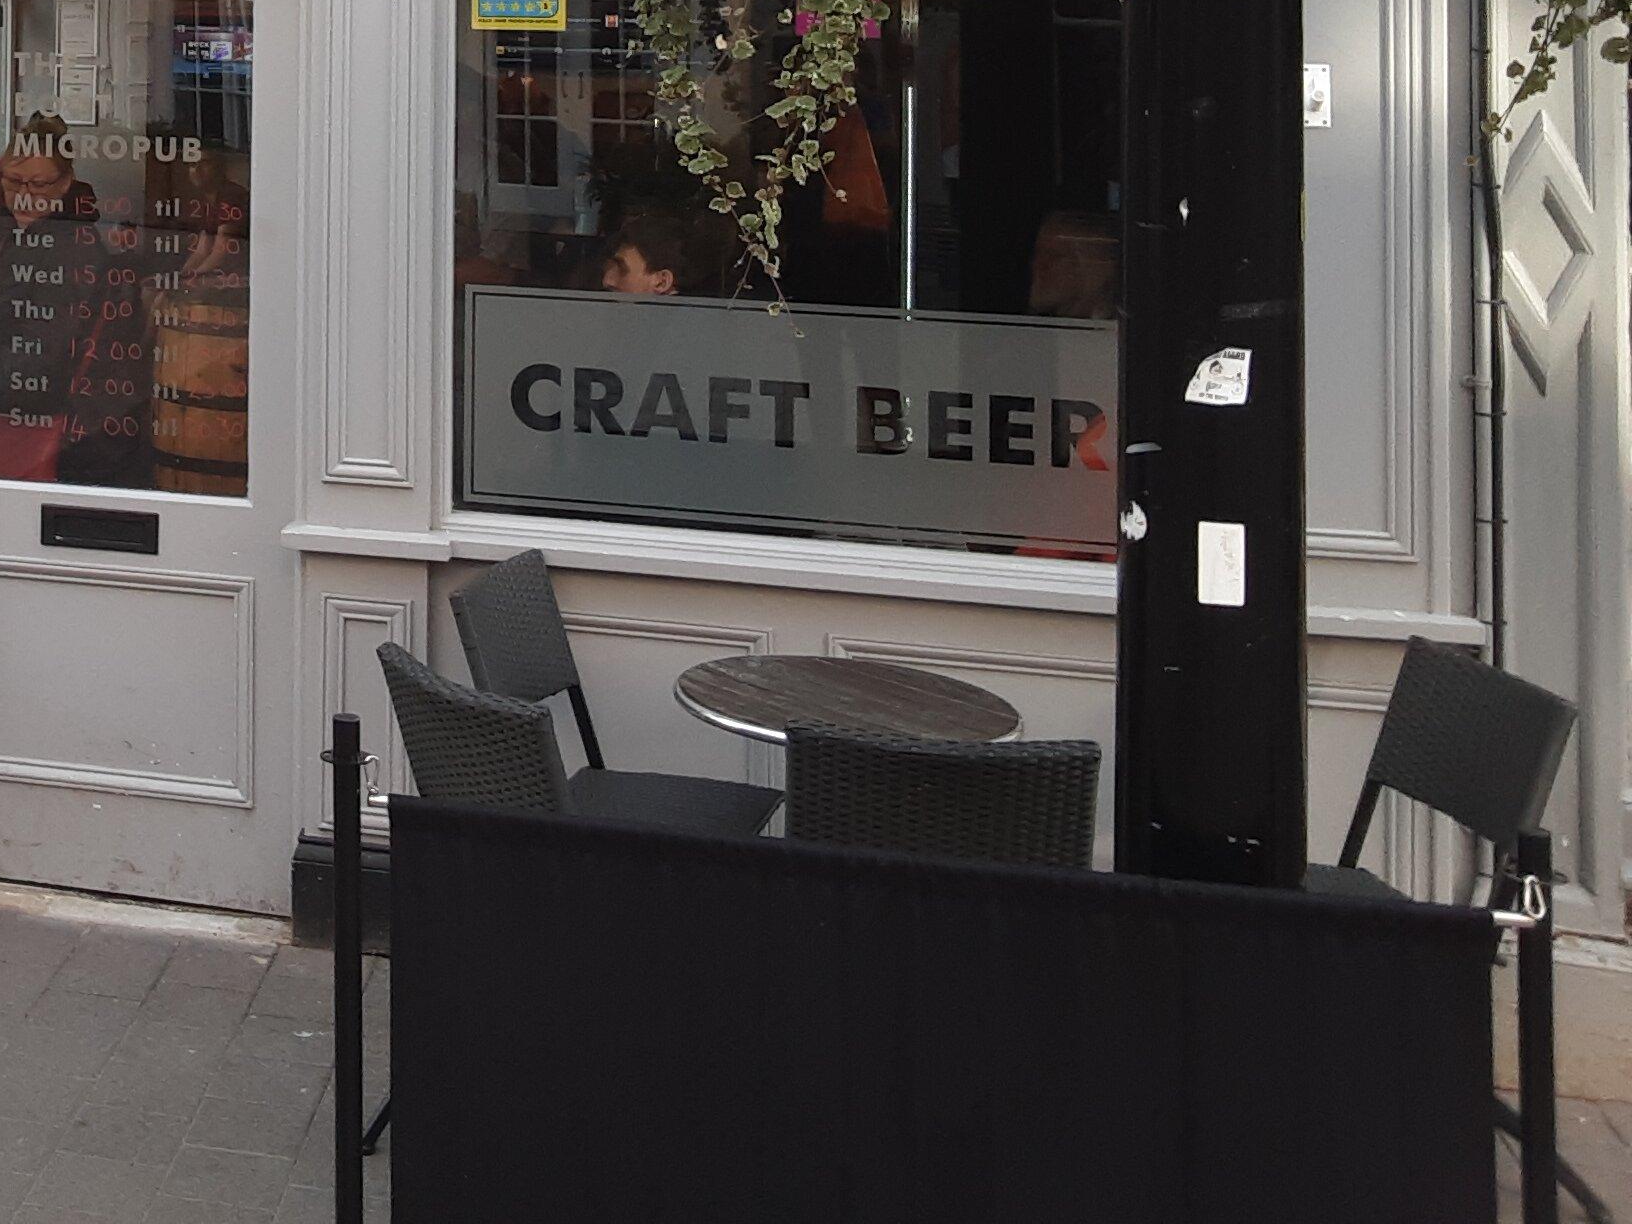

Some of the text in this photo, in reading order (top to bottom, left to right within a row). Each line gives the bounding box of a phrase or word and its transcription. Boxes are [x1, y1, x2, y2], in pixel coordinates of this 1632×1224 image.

[13, 133, 203, 163] MICROPUB
[13, 193, 64, 213] Mon
[155, 198, 180, 217] til
[13, 228, 55, 248] Tue
[155, 234, 180, 254] til
[11, 264, 64, 284] Wed
[155, 271, 180, 290] til
[11, 300, 54, 321] Thu
[11, 335, 42, 355] Fri
[10, 372, 49, 392] Sat
[9, 407, 53, 428] Sun
[510, 363, 1110, 471] CRAFT BEER
